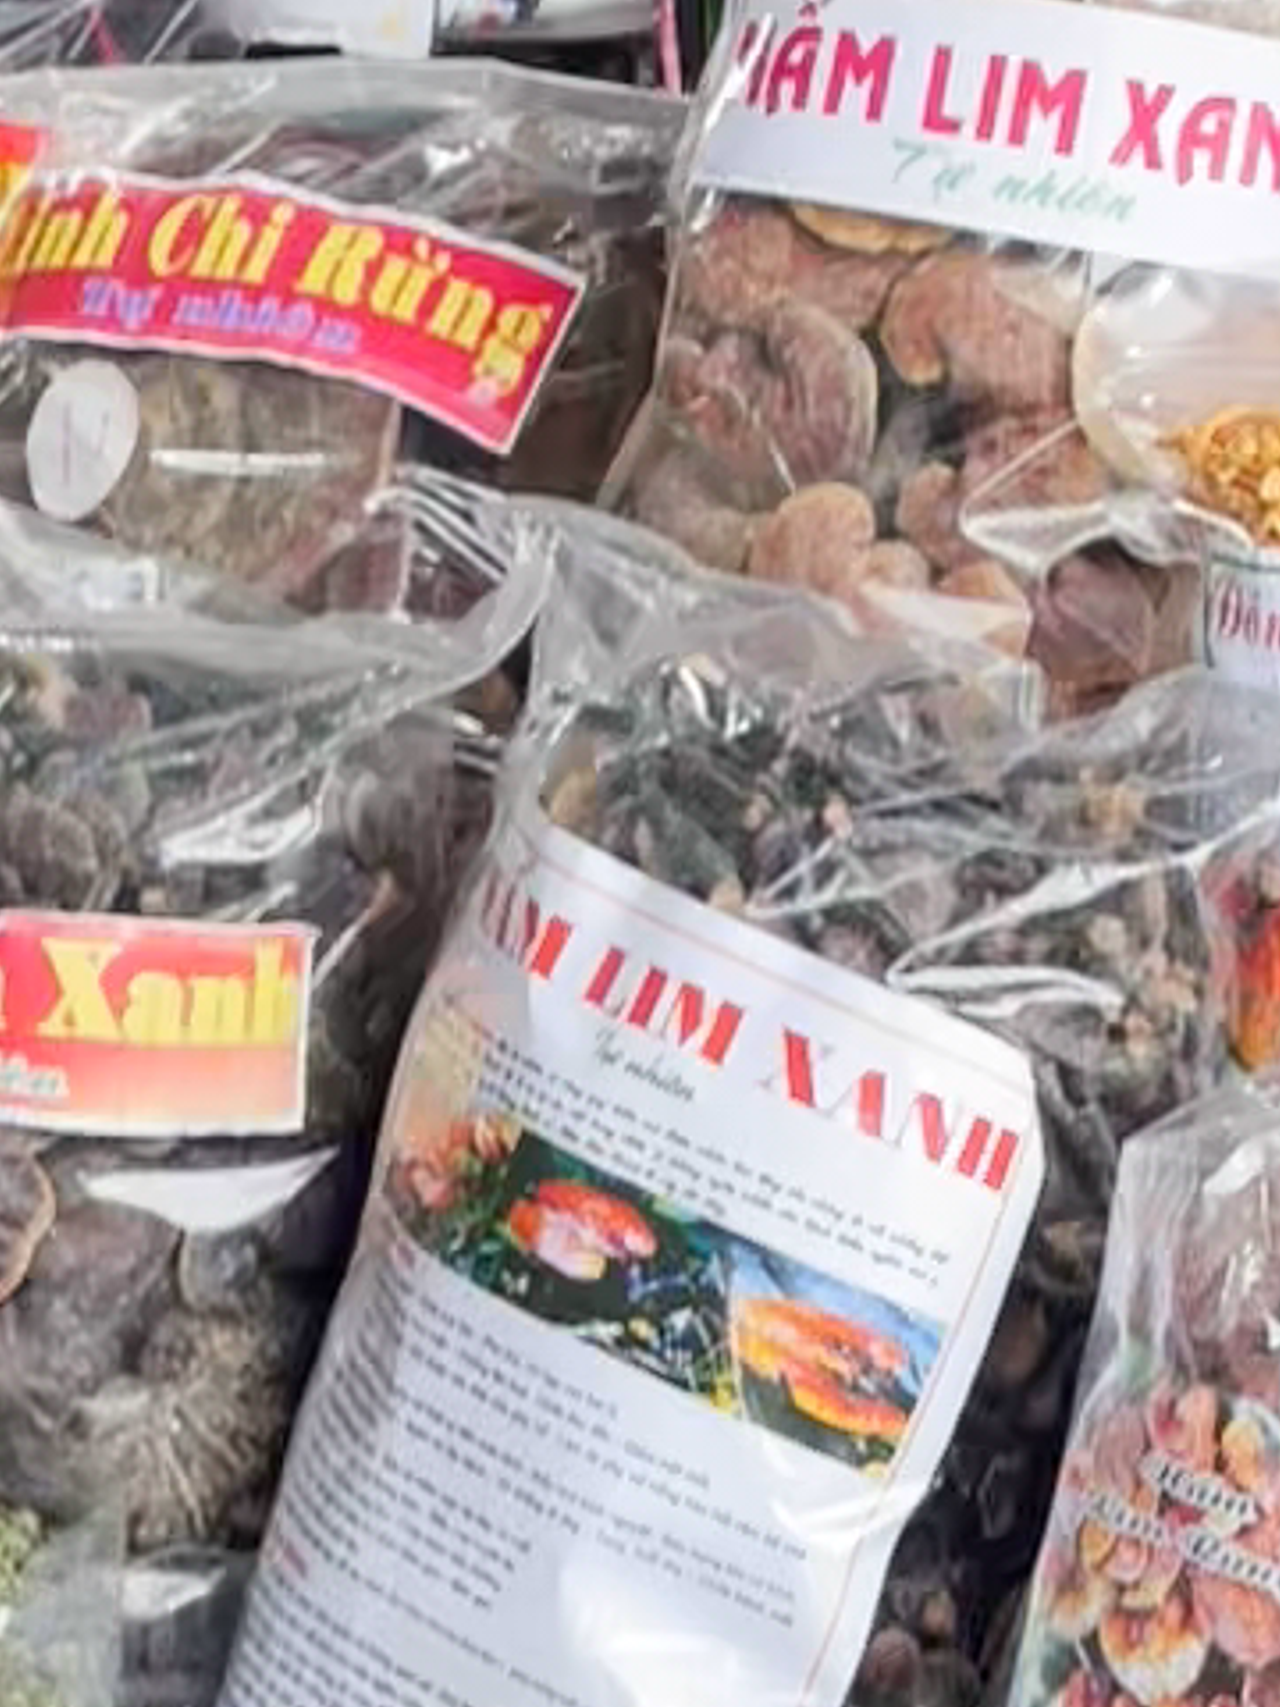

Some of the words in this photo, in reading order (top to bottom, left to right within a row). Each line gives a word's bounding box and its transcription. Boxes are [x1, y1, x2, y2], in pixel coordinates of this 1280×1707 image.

[921, 43, 1088, 158] LIM
[147, 195, 297, 285] Chi
[295, 221, 553, 405] Rừng
[37, 935, 301, 1047] Xanh
[582, 943, 747, 1069] LIM
[758, 1023, 1022, 1194] XANH
